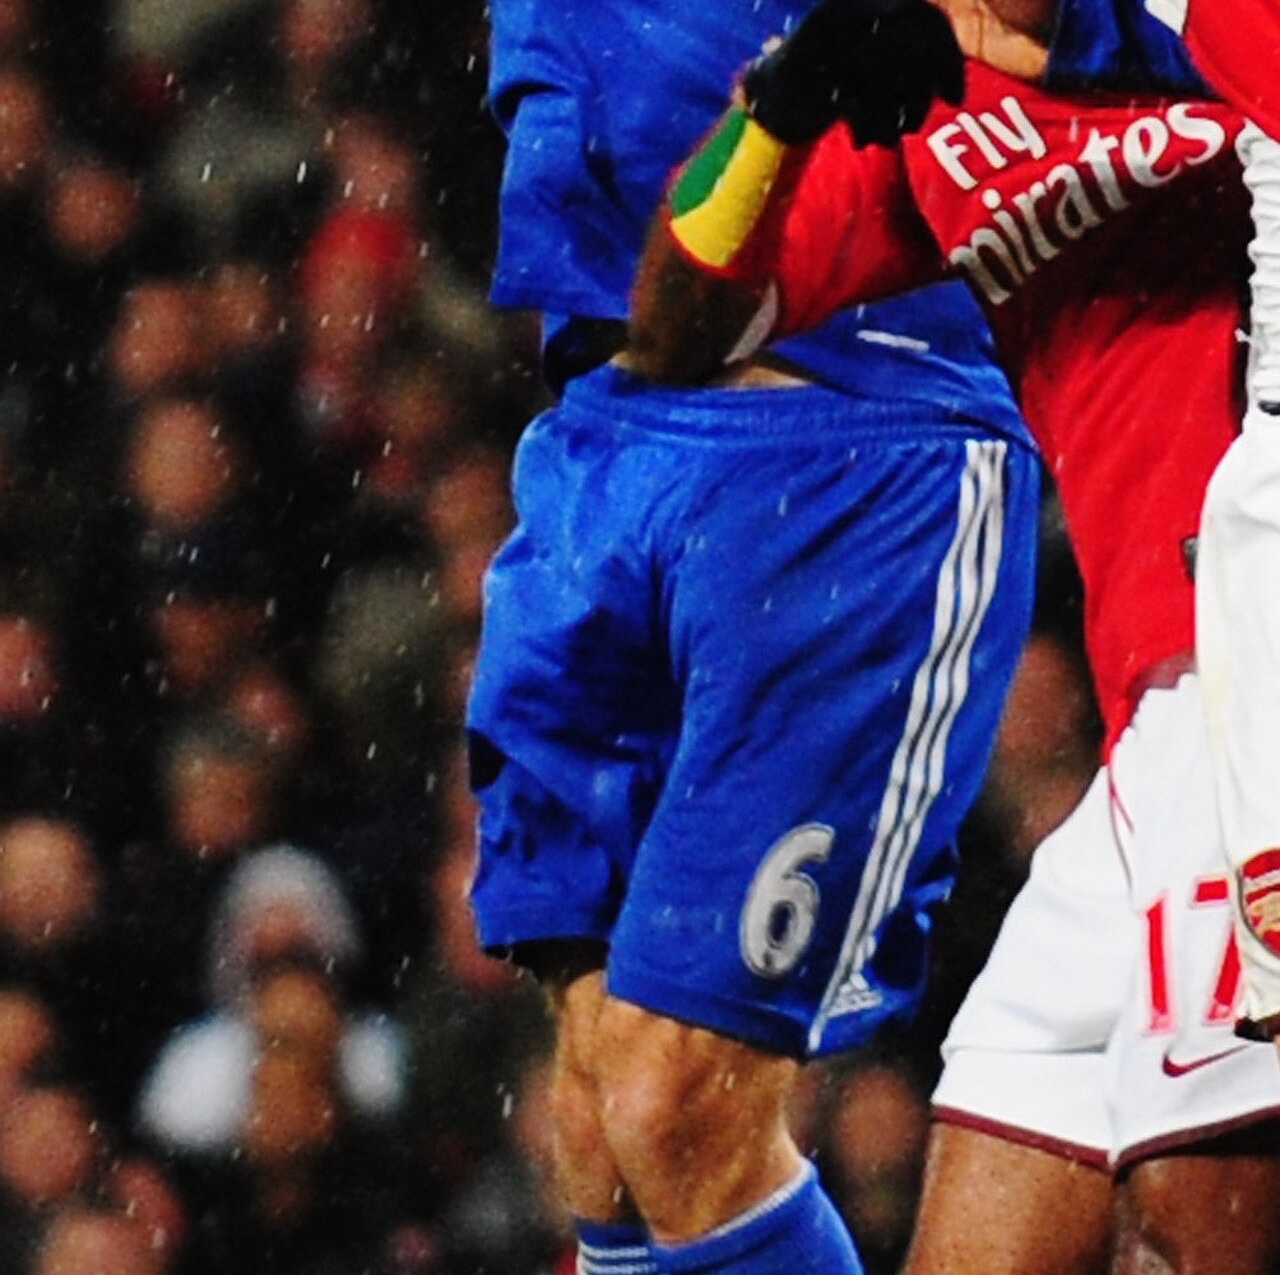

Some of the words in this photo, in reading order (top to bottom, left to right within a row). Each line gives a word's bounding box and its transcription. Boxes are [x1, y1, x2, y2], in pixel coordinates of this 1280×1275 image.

[926, 95, 1047, 191] Fly
[739, 821, 836, 979] 6
[1142, 877, 1243, 1037] 17
